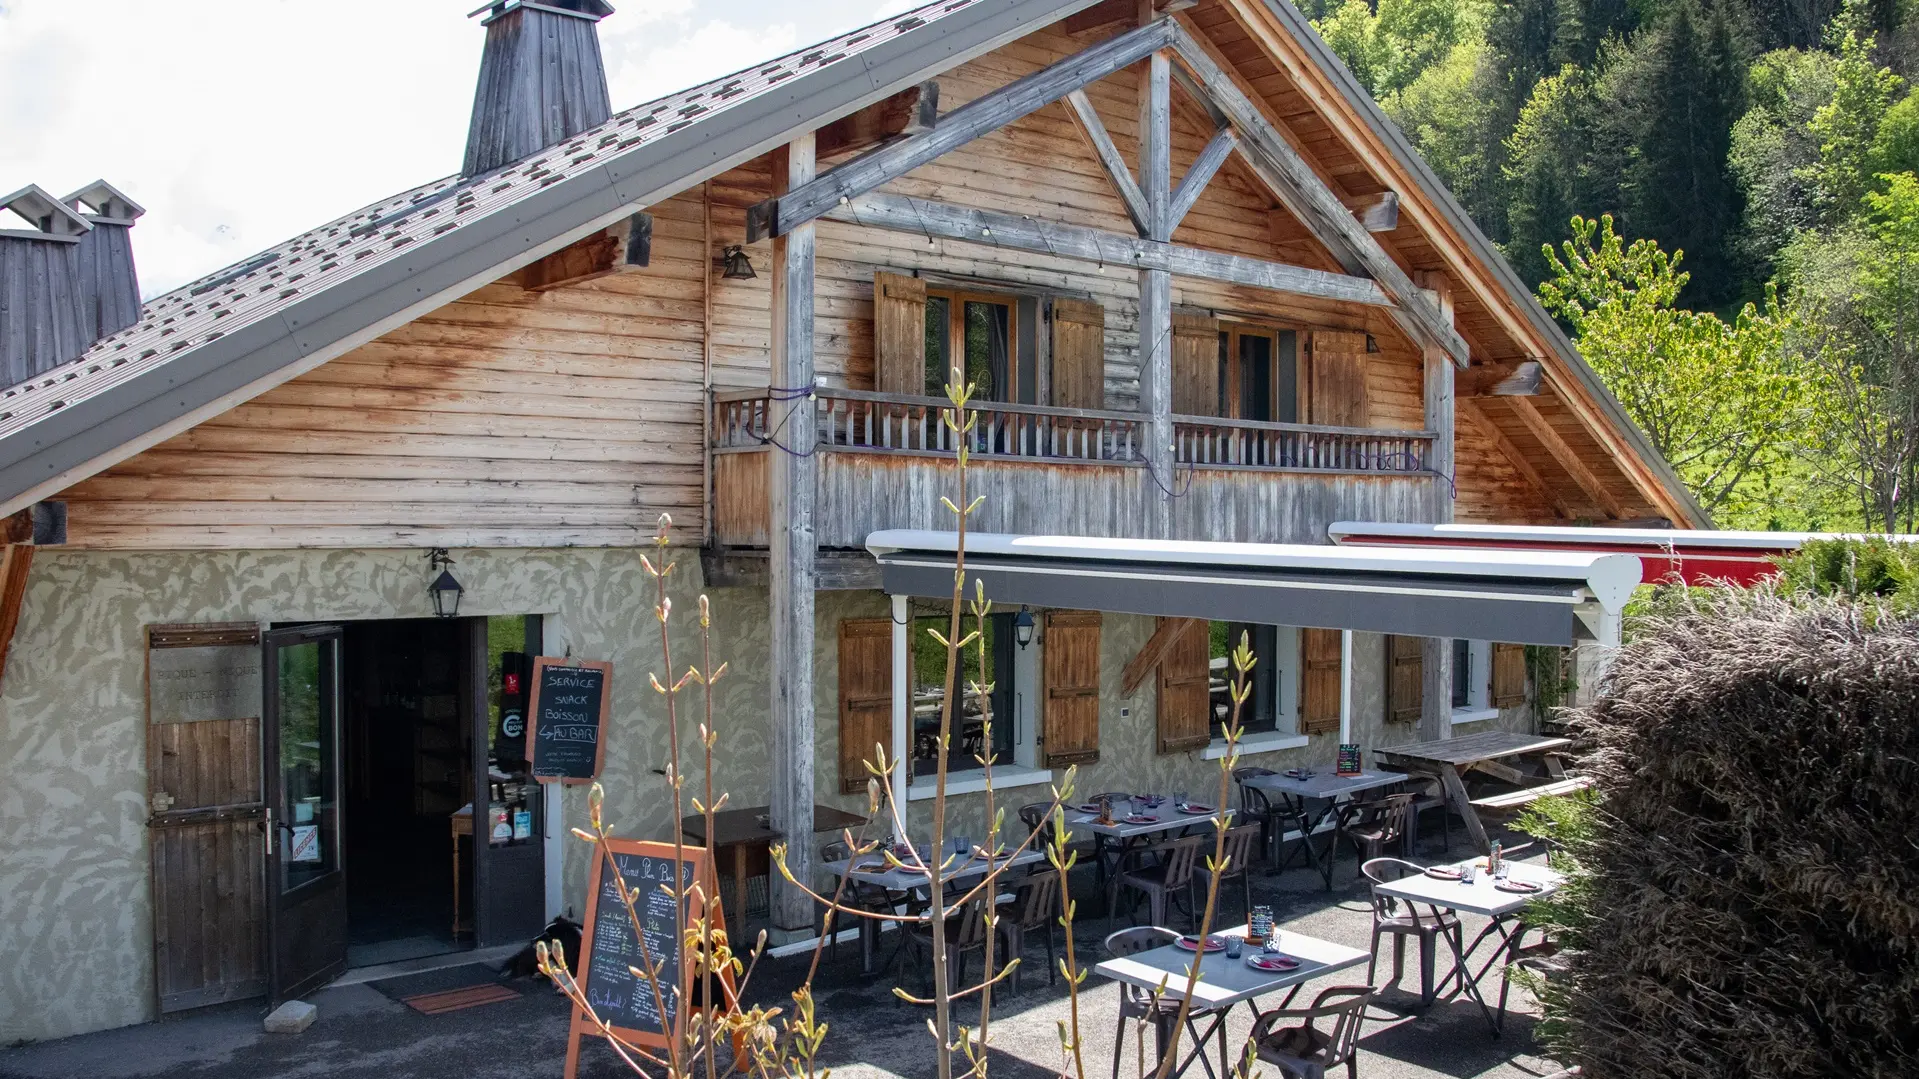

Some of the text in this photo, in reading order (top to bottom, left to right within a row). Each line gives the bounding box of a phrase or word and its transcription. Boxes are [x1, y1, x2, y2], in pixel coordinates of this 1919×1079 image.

[157, 669, 196, 680] PIQUE
[547, 677, 595, 688] SERVICE
[176, 688, 240, 701] INTERDIT
[554, 695, 588, 705] SNACK
[555, 727, 595, 741] AU BAR
